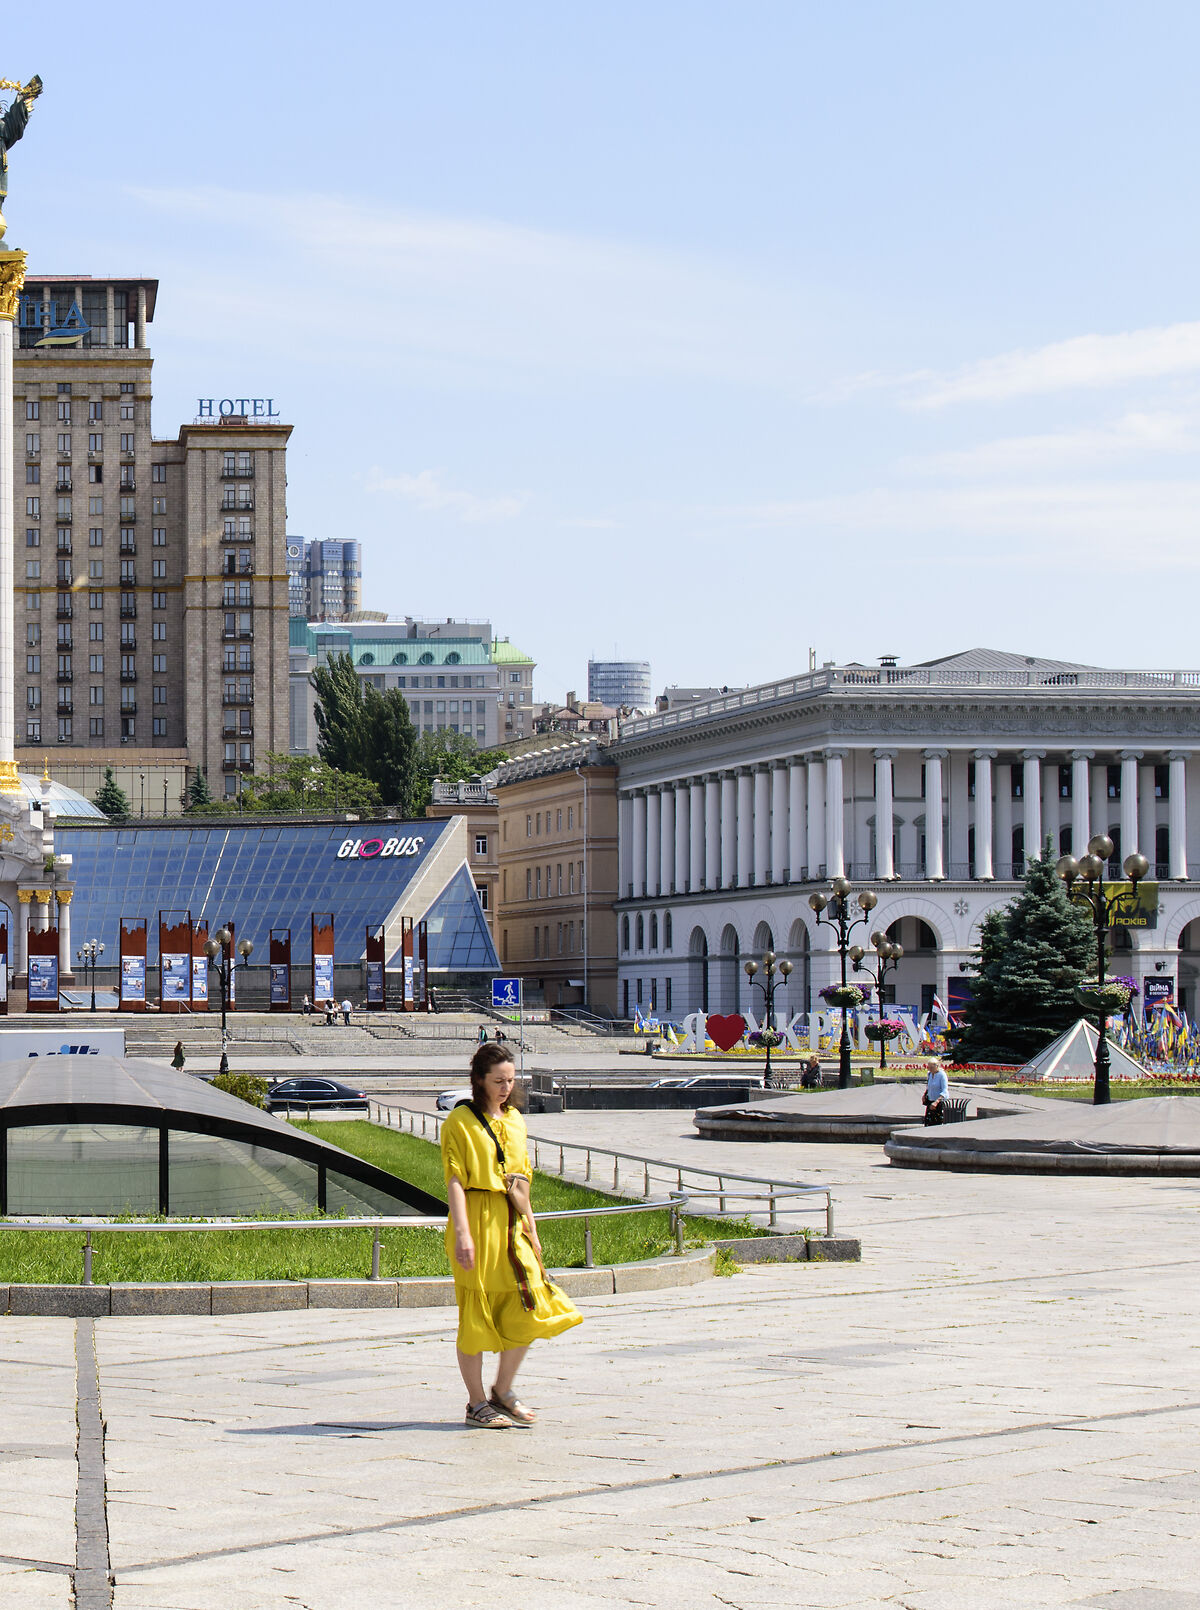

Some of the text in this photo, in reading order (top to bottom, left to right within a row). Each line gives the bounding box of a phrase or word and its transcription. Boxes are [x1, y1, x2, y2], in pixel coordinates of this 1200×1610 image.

[197, 398, 280, 416] HOTEL
[337, 836, 424, 858] GLOBUS
[1115, 917, 1147, 925] РОКІВ
[1149, 983, 1169, 991] ВІЙНА
[680, 1012, 707, 1051] Я
